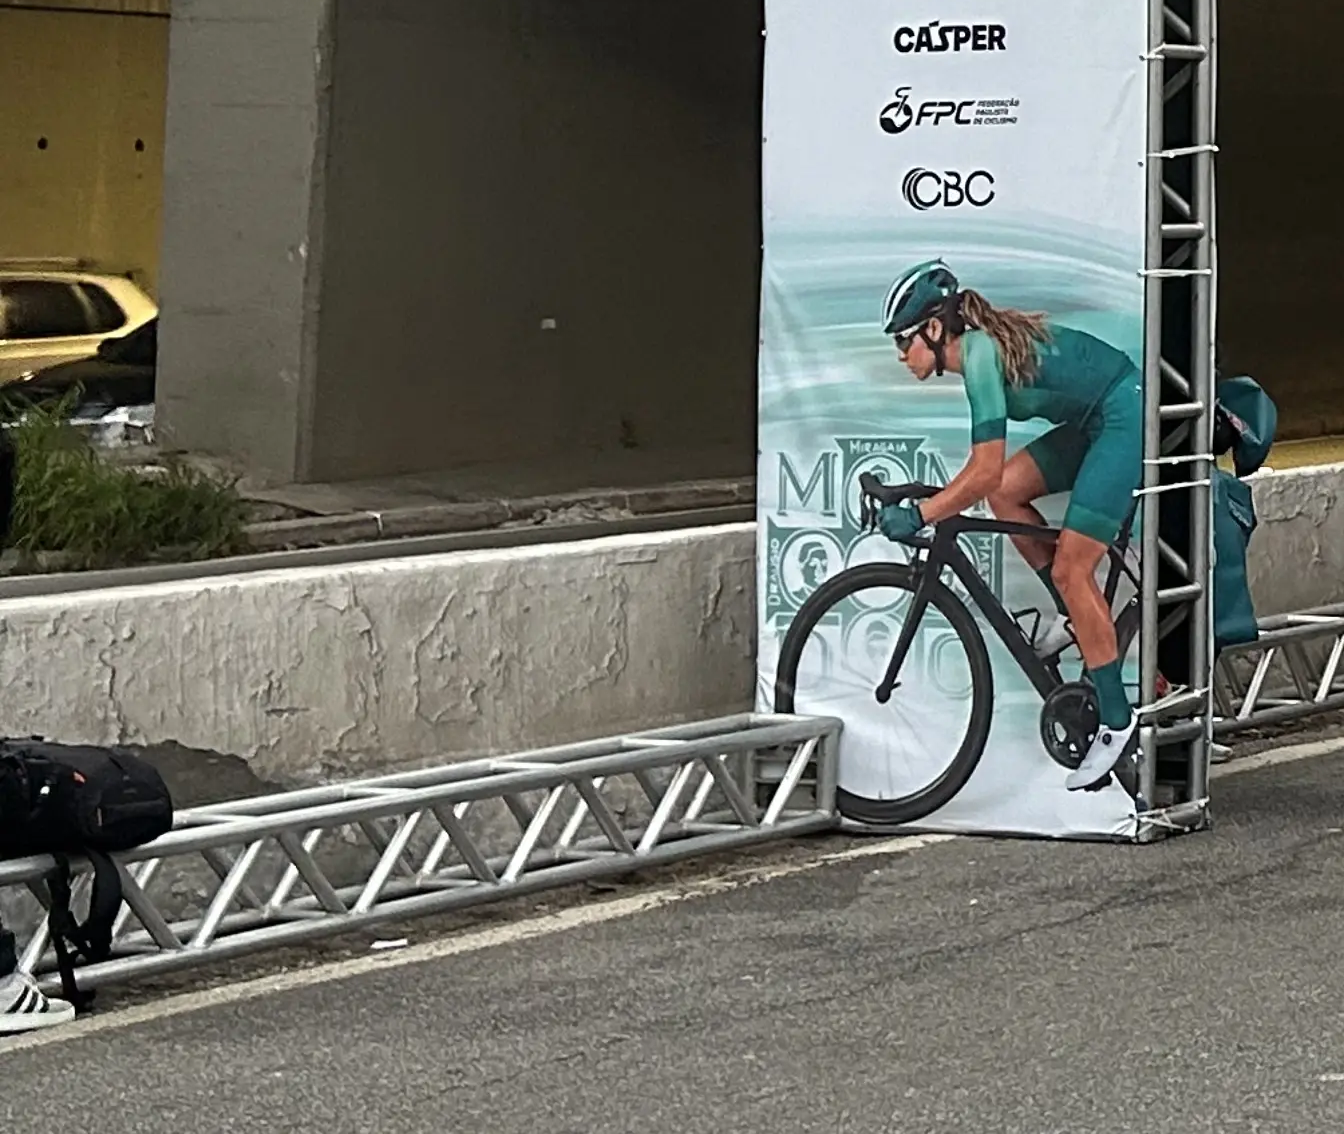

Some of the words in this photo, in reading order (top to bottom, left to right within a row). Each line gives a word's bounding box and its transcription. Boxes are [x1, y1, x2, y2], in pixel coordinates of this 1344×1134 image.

[894, 20, 1007, 53] CÁSPER
[915, 99, 977, 127] FPC
[902, 167, 995, 211] CBC
